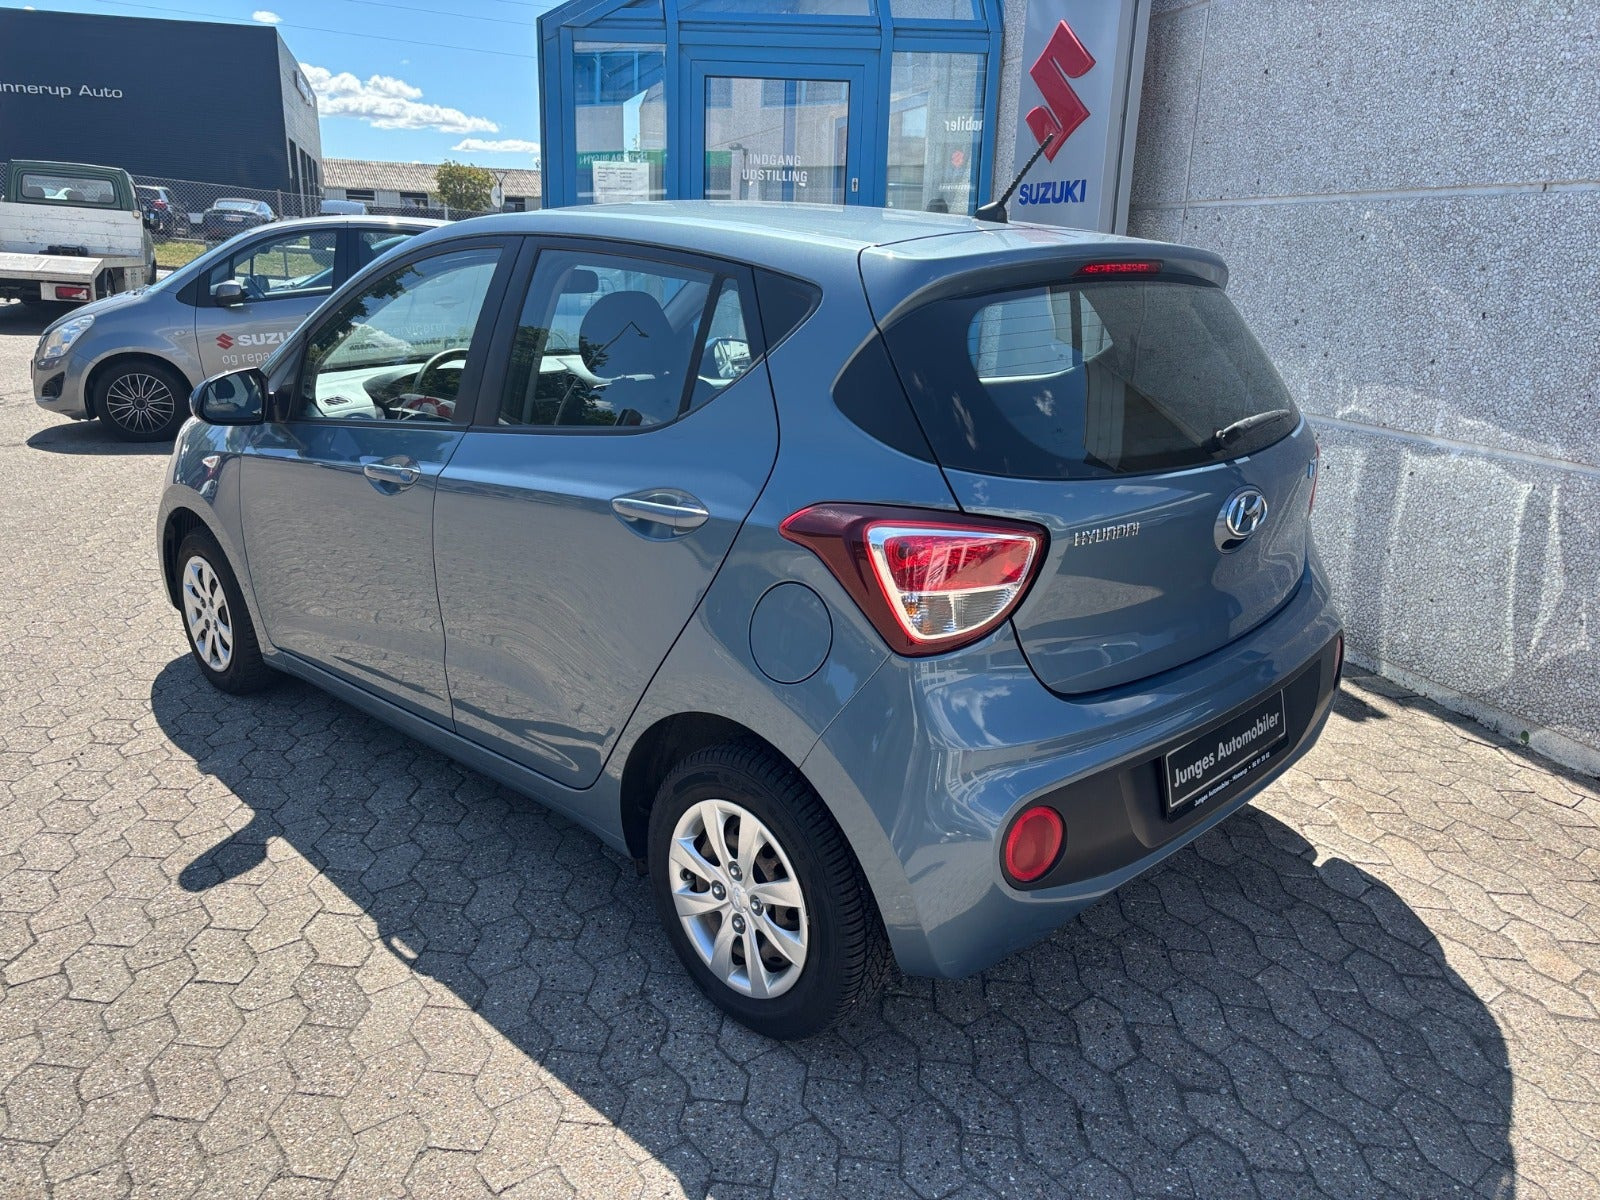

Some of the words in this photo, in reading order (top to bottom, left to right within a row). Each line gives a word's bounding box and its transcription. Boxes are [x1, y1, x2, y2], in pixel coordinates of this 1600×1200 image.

[79, 84, 123, 98] Auto
[749, 153, 801, 166] INDGANG
[742, 168, 808, 183] UDSTILLING
[1018, 179, 1087, 206] SUZUKI
[222, 354, 238, 366] og
[1074, 521, 1140, 547] HYUNDAI
[1174, 752, 1215, 788] Junges
[1217, 712, 1280, 761] Automobiler
